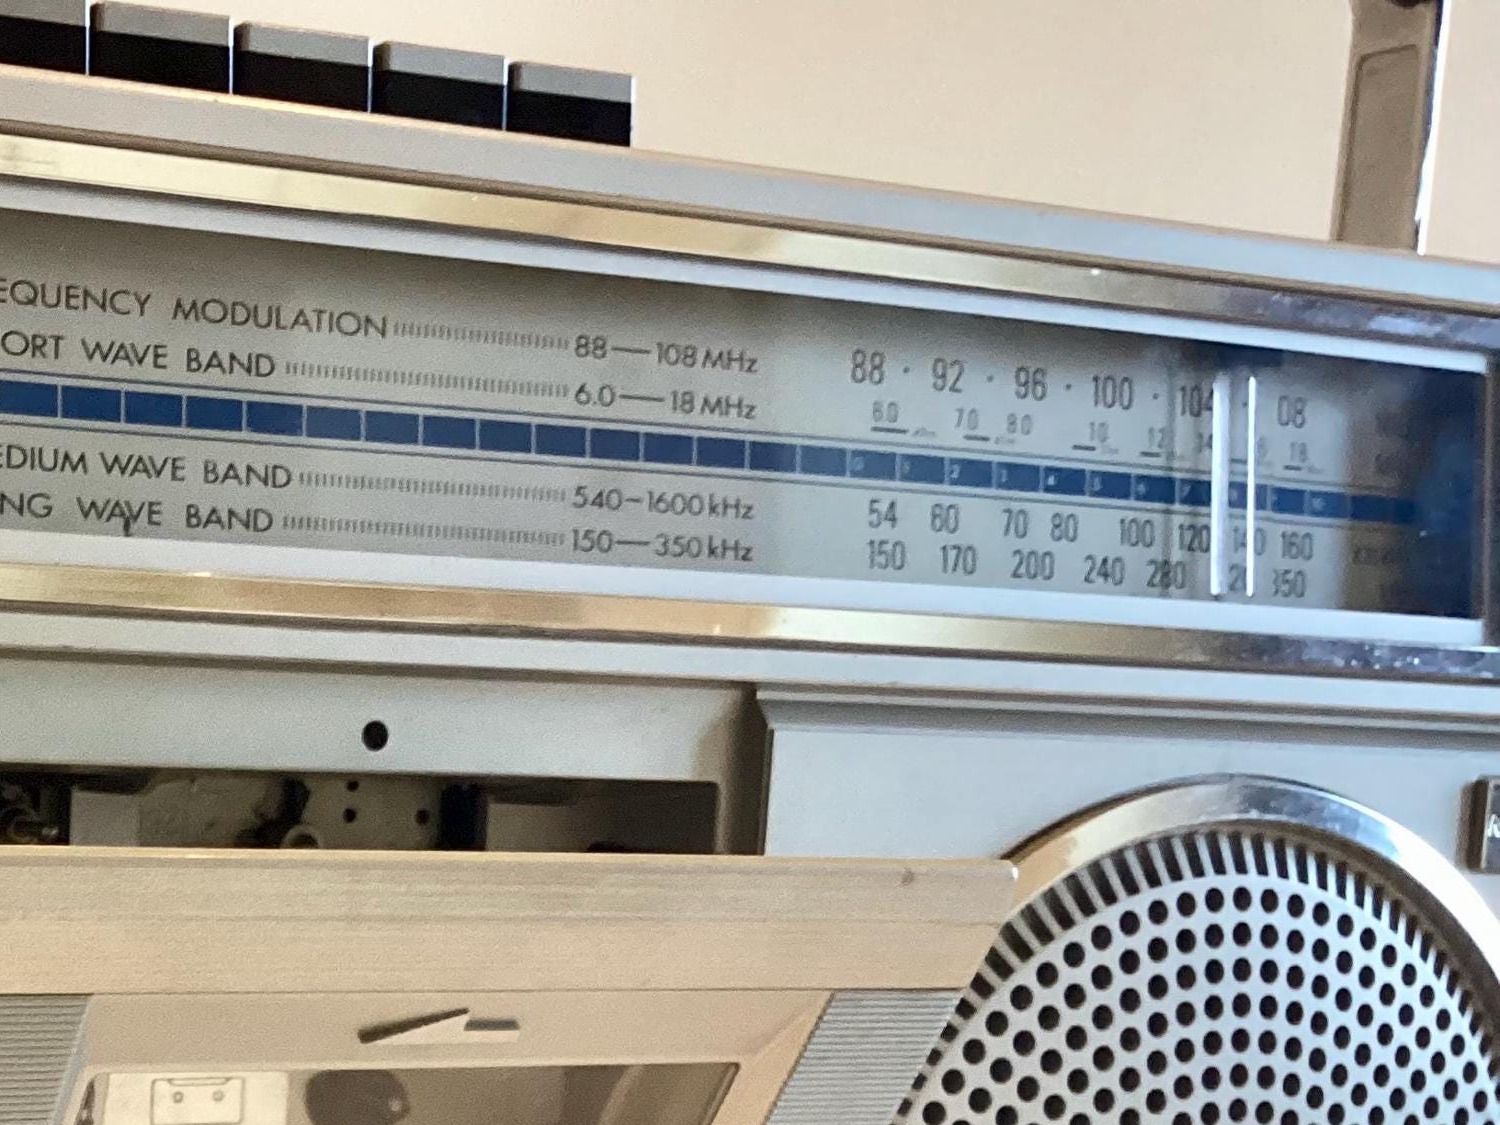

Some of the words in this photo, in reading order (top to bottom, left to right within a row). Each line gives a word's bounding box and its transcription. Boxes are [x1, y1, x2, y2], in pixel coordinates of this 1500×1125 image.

[172, 298, 389, 339] MODULATION
[80, 338, 169, 371] WAVE
[186, 348, 277, 379] BAND
[851, 348, 886, 386] 88
[932, 357, 965, 394] 92
[1013, 366, 1048, 401] 96
[1091, 374, 1134, 411] 100
[100, 451, 187, 483] WAVE
[203, 459, 293, 489] BAND
[76, 497, 163, 530] WAVE
[185, 505, 275, 534] BAND
[867, 498, 898, 530] 54
[1001, 507, 1030, 539] 70
[1118, 516, 1155, 549] 100
[866, 539, 908, 571] 150
[939, 543, 979, 576] 170
[1010, 547, 1055, 581] 200
[1083, 552, 1126, 586] 240
